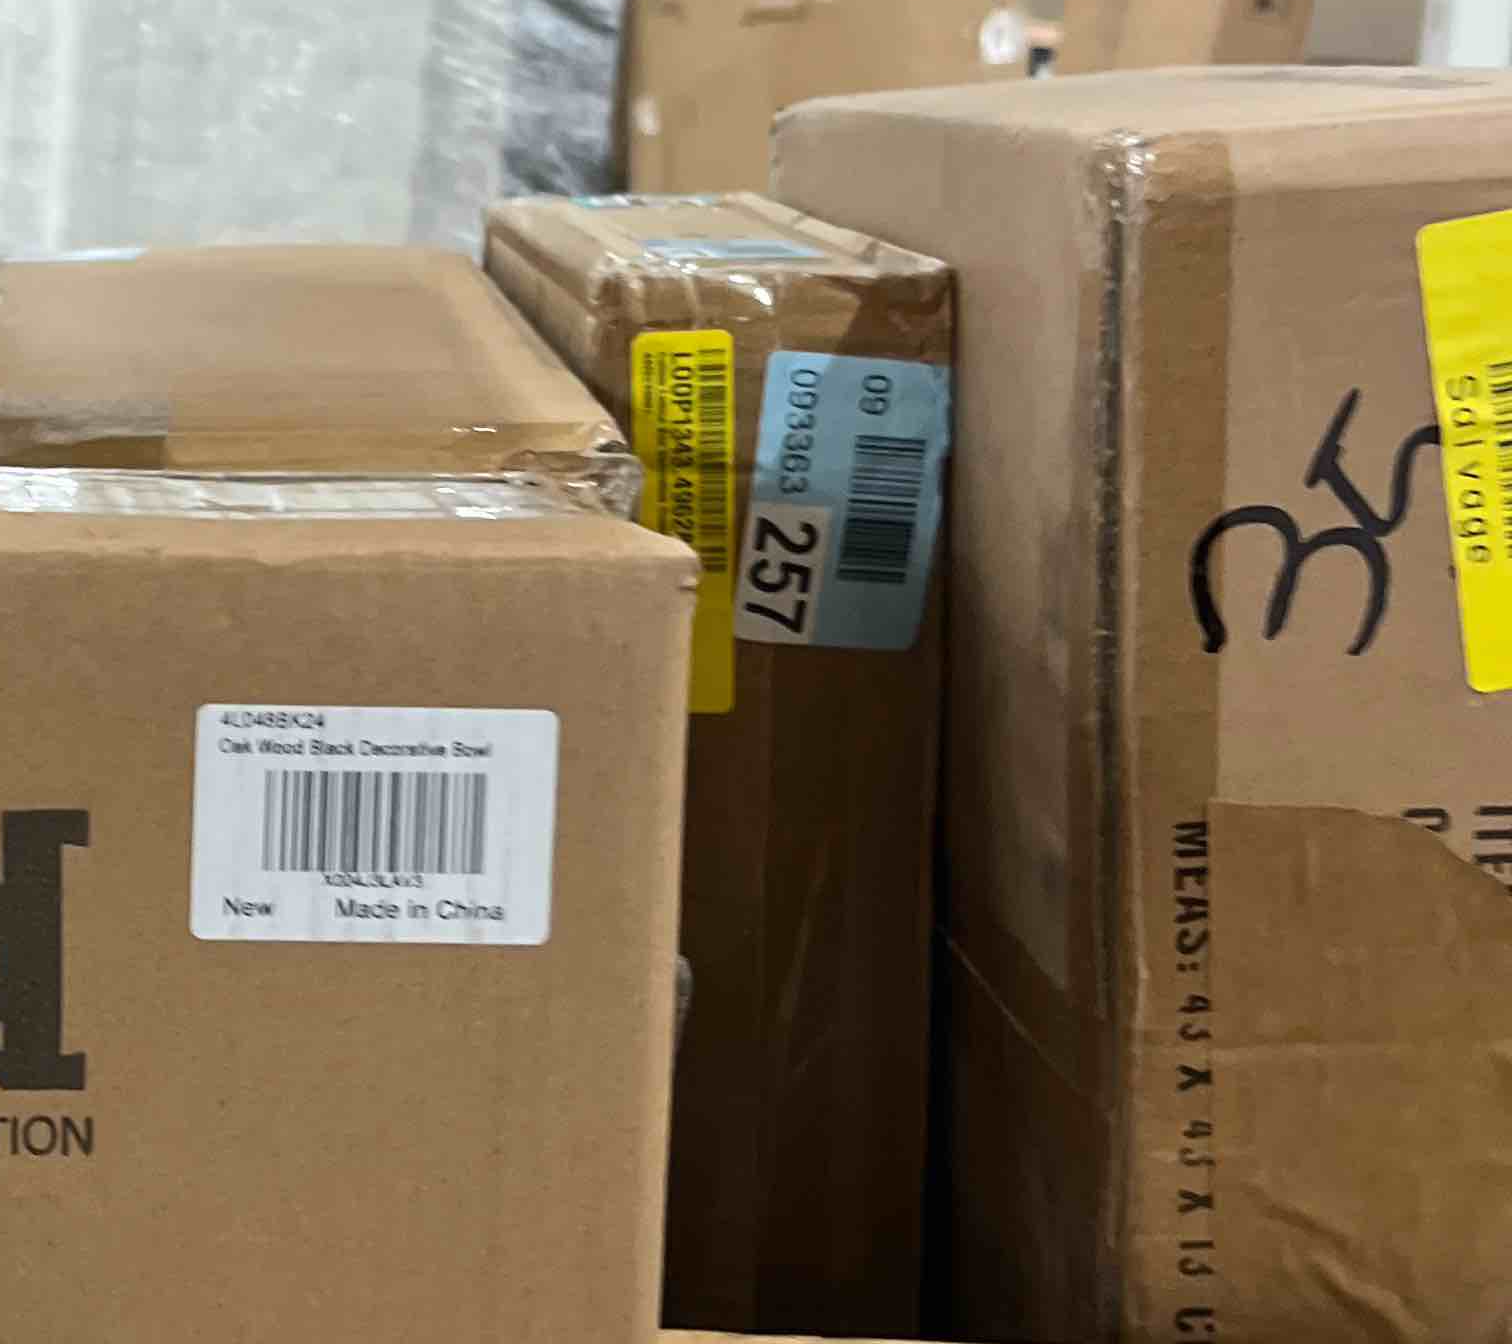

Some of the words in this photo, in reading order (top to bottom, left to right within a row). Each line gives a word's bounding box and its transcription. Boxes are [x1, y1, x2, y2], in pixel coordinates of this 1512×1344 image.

[780, 368, 821, 496] 093363
[857, 374, 894, 417] 09
[1445, 374, 1492, 565] Salvage
[744, 515, 819, 636] 257
[218, 737, 253, 755] Oak
[257, 737, 304, 755] Wood
[310, 738, 355, 756] Black
[359, 739, 446, 757] Decorative
[452, 740, 493, 758] Bowl
[223, 896, 274, 918] New
[334, 897, 401, 920] Made
[407, 898, 429, 920] in
[434, 898, 505, 921] China
